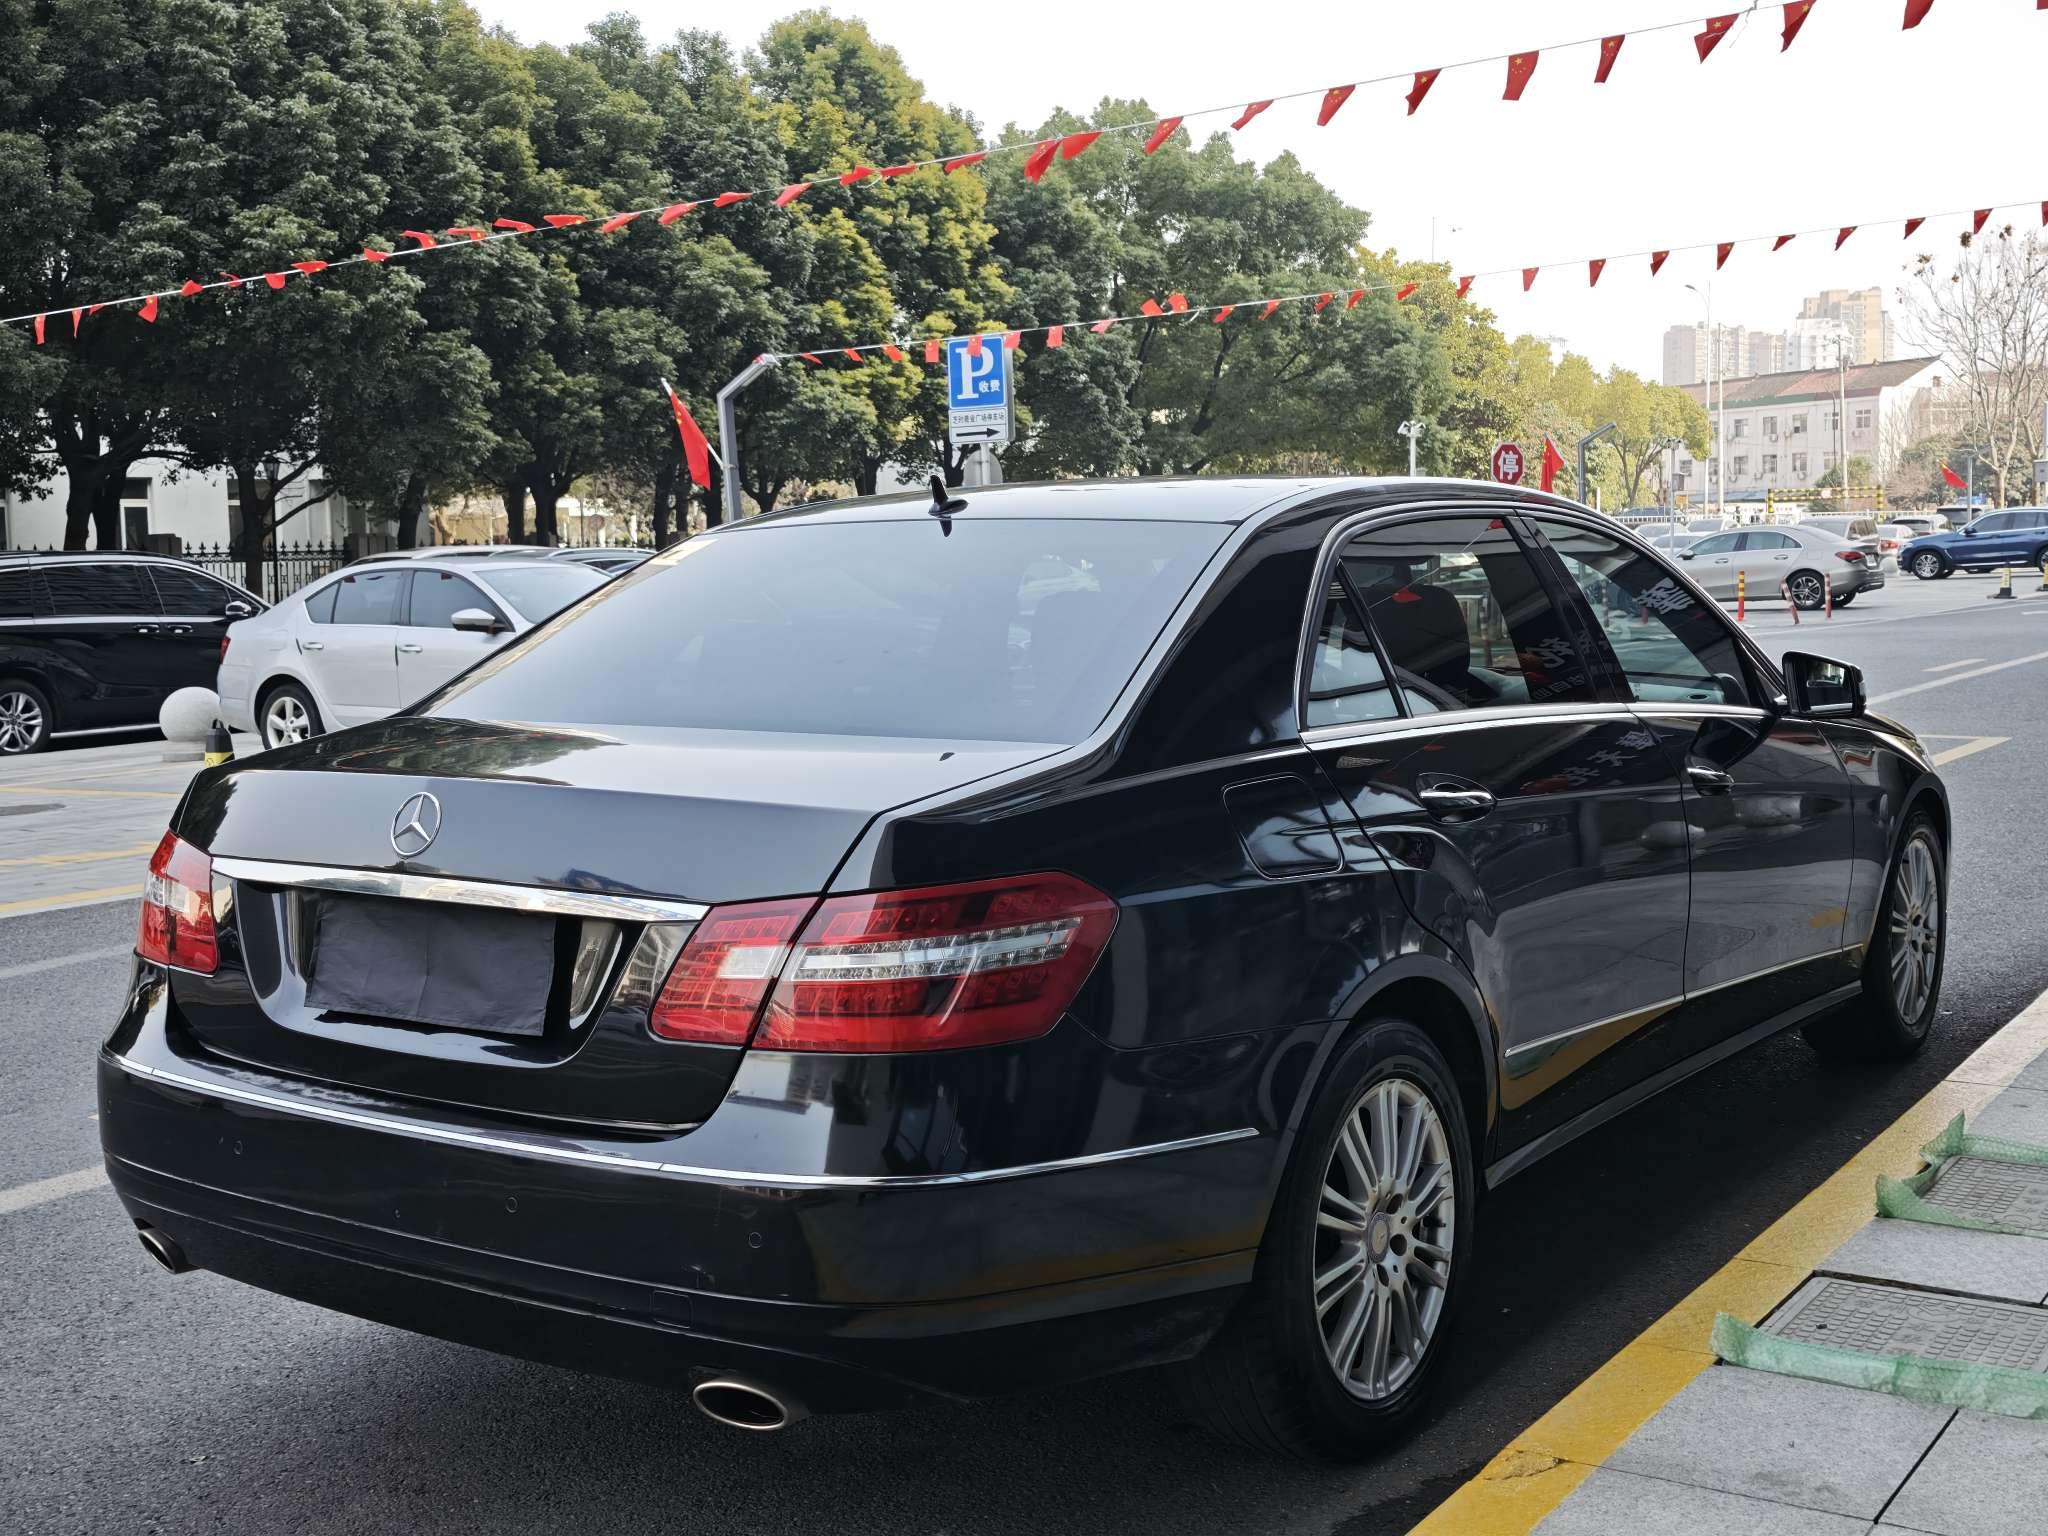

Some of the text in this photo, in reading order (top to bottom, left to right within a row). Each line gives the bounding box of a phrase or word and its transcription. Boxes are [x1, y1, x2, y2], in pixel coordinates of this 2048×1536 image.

[955, 347, 994, 399] P
[978, 379, 1001, 393] 收费
[1498, 450, 1519, 481] 停
